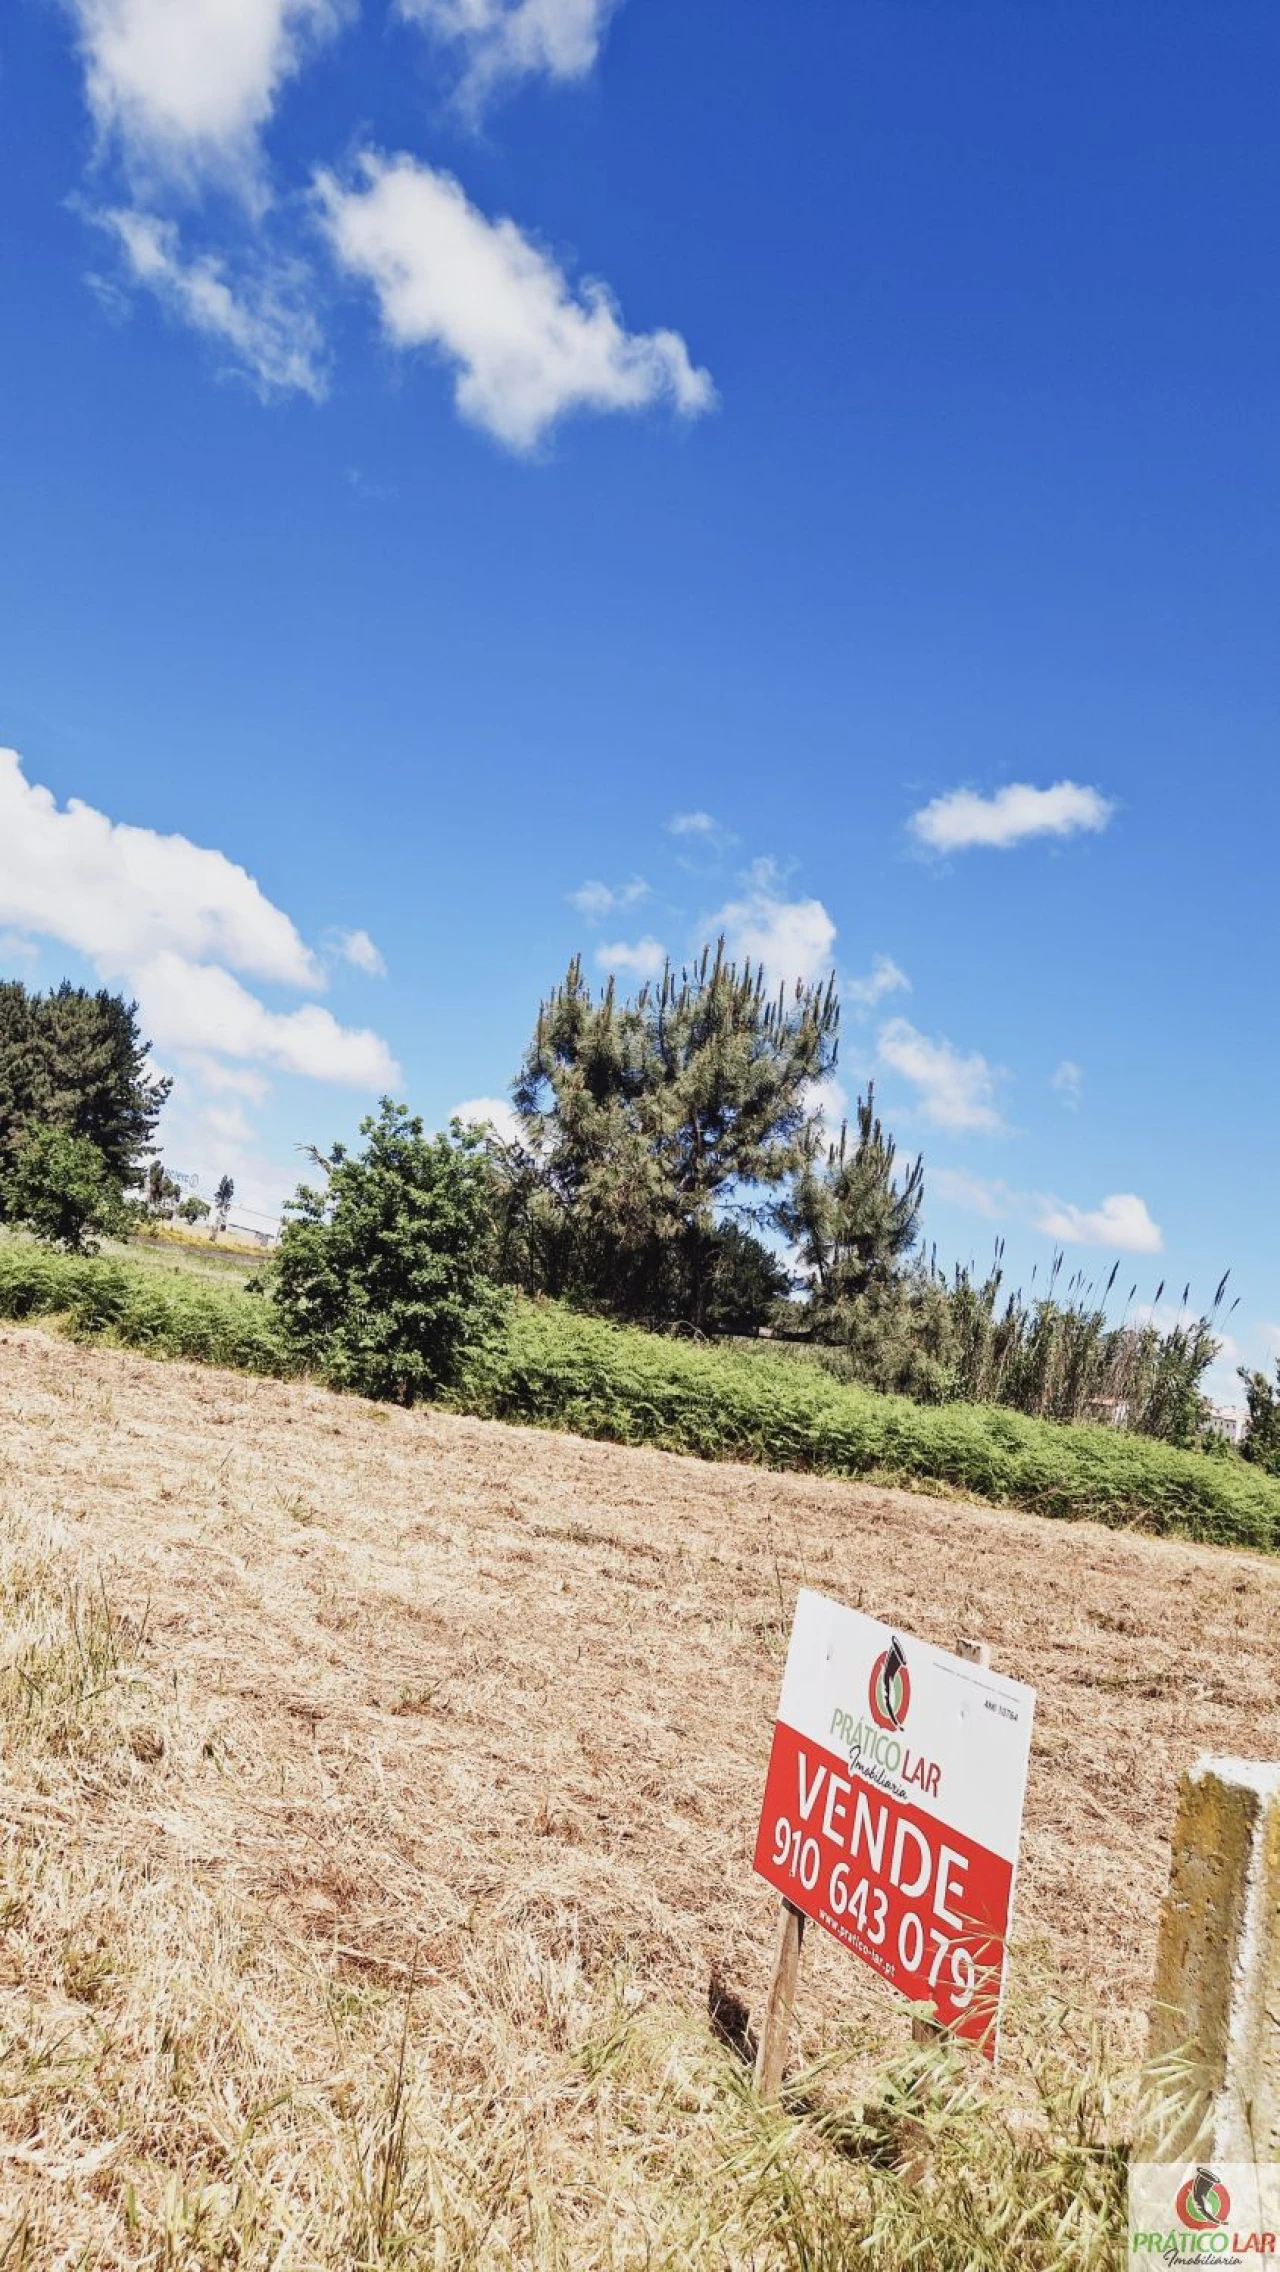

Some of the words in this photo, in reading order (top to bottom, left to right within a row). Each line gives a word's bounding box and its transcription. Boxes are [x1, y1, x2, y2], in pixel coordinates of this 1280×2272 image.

[798, 1751, 969, 1931] VENDE
[830, 1708, 901, 1771] PRÁTICO
[902, 1749, 941, 1798] LAR
[772, 1817, 821, 1890] 910
[829, 1862, 889, 1945] 643
[898, 1912, 975, 2008] 079
